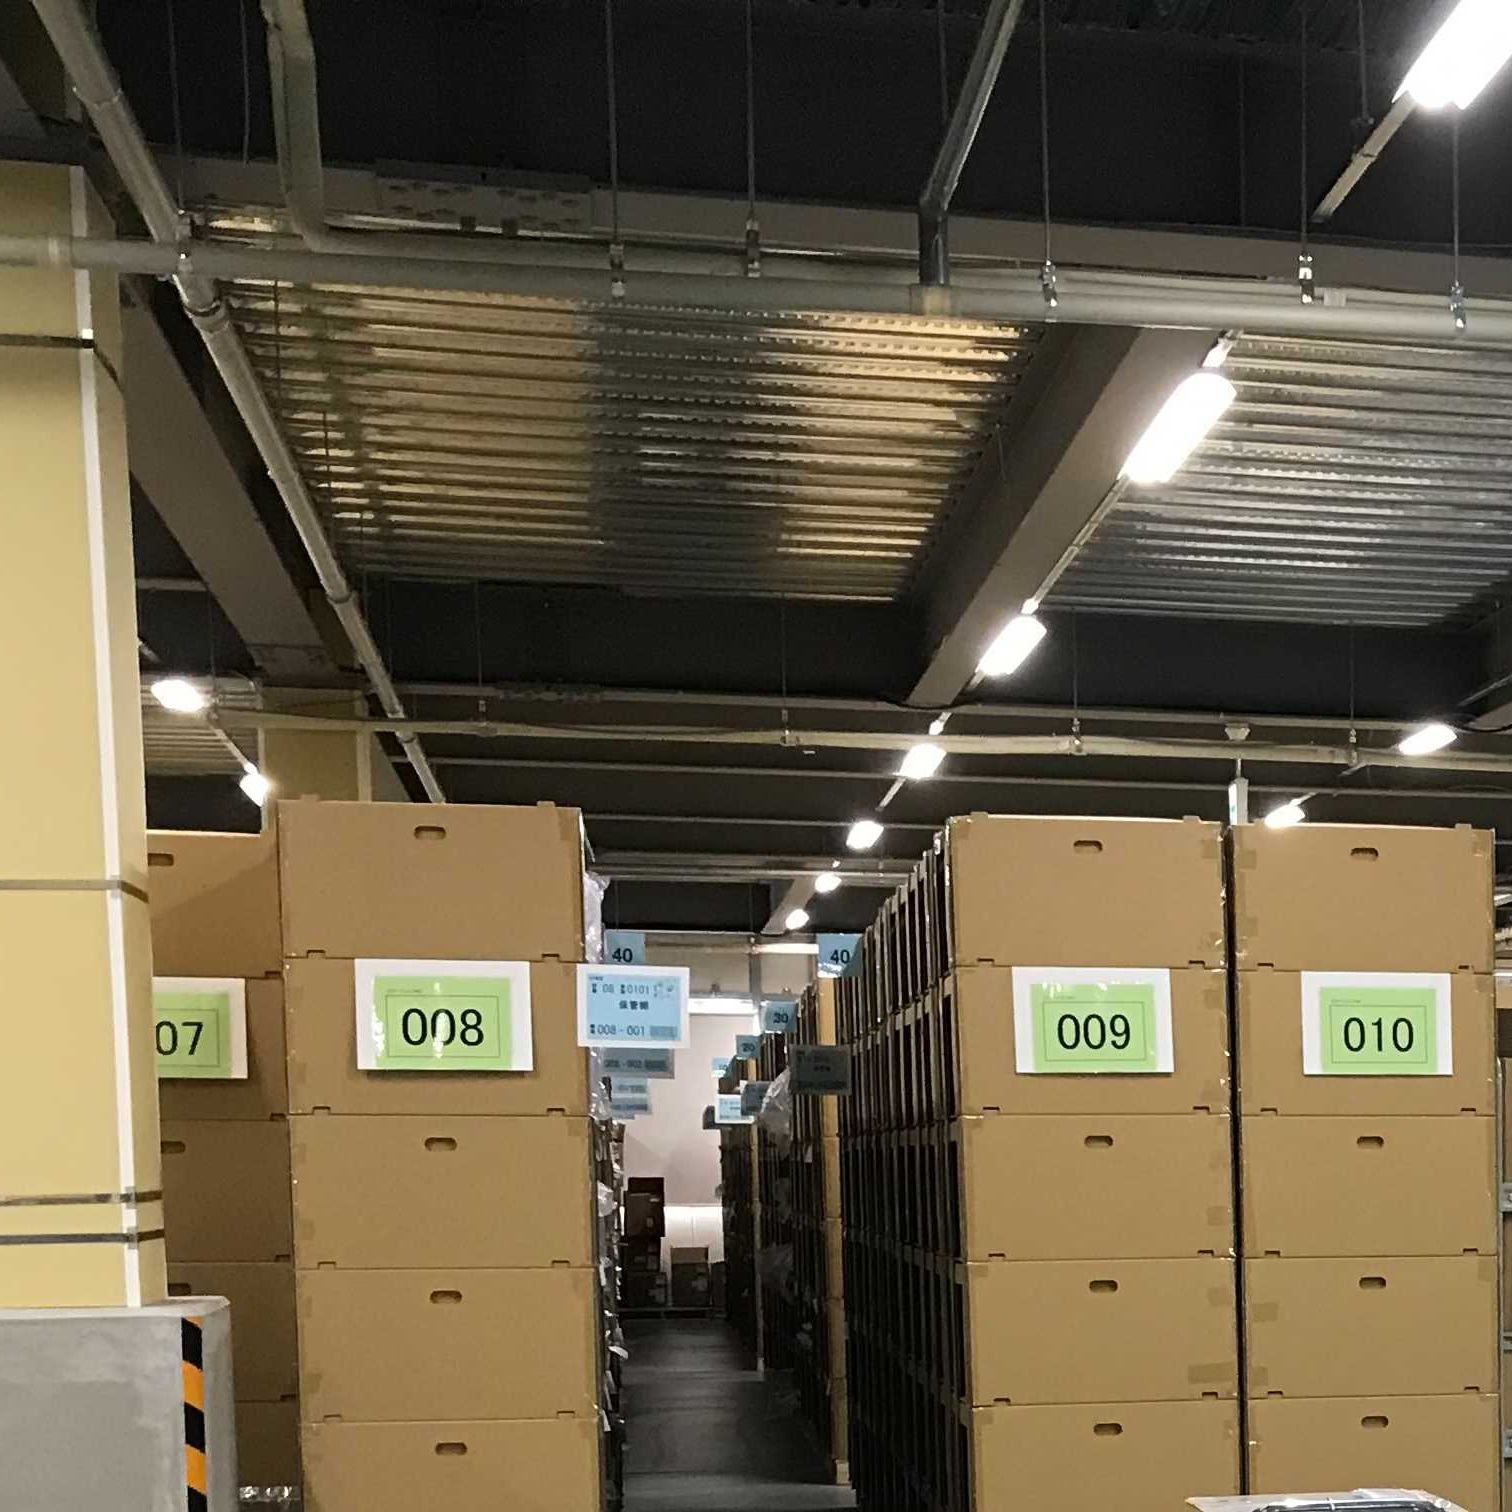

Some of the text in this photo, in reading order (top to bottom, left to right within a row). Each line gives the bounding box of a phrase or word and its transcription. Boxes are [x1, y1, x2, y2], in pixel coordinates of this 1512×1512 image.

[612, 948, 633, 963] 40
[830, 949, 851, 964] 40
[402, 1008, 484, 1047] 008
[1057, 1013, 1131, 1050] 009
[1343, 1016, 1414, 1053] 010
